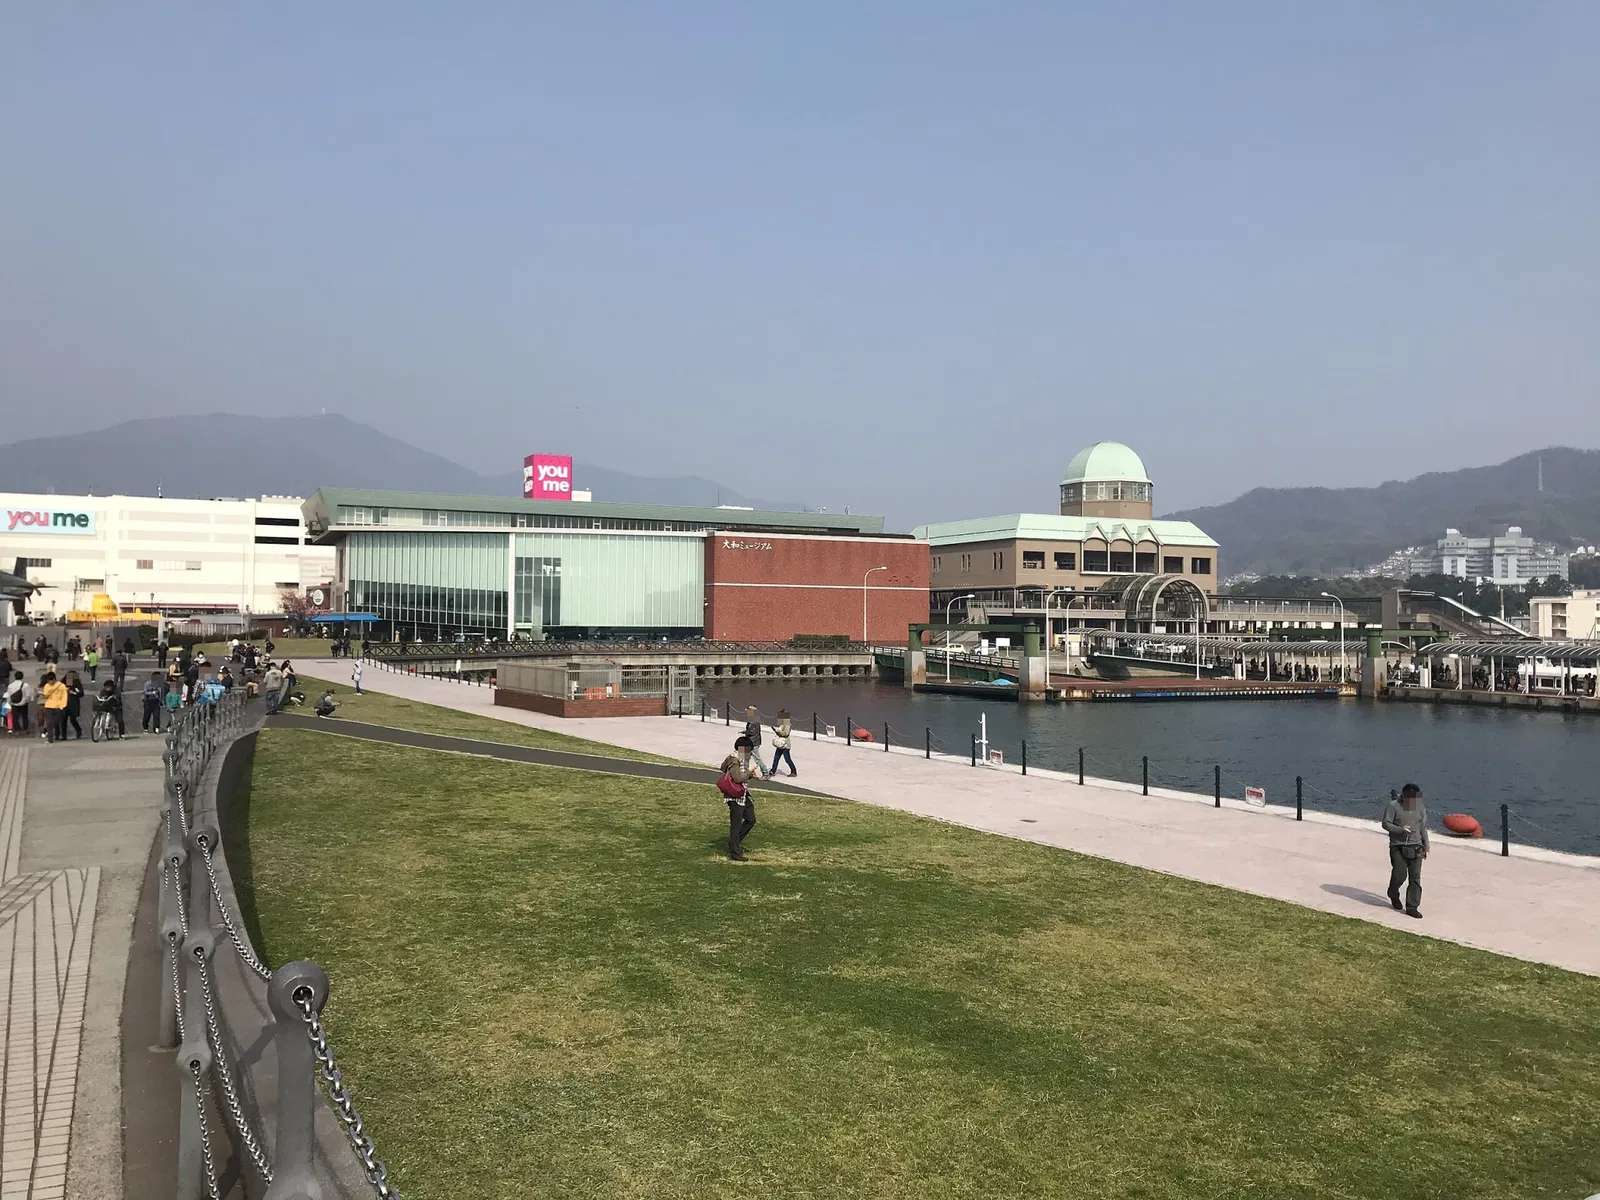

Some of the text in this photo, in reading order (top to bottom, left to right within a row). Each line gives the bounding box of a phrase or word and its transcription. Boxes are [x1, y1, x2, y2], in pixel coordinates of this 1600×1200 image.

[537, 464, 568, 481] you
[543, 480, 570, 492] me
[7, 510, 89, 530] you me
[721, 539, 773, 551] 大和ミュージアム
